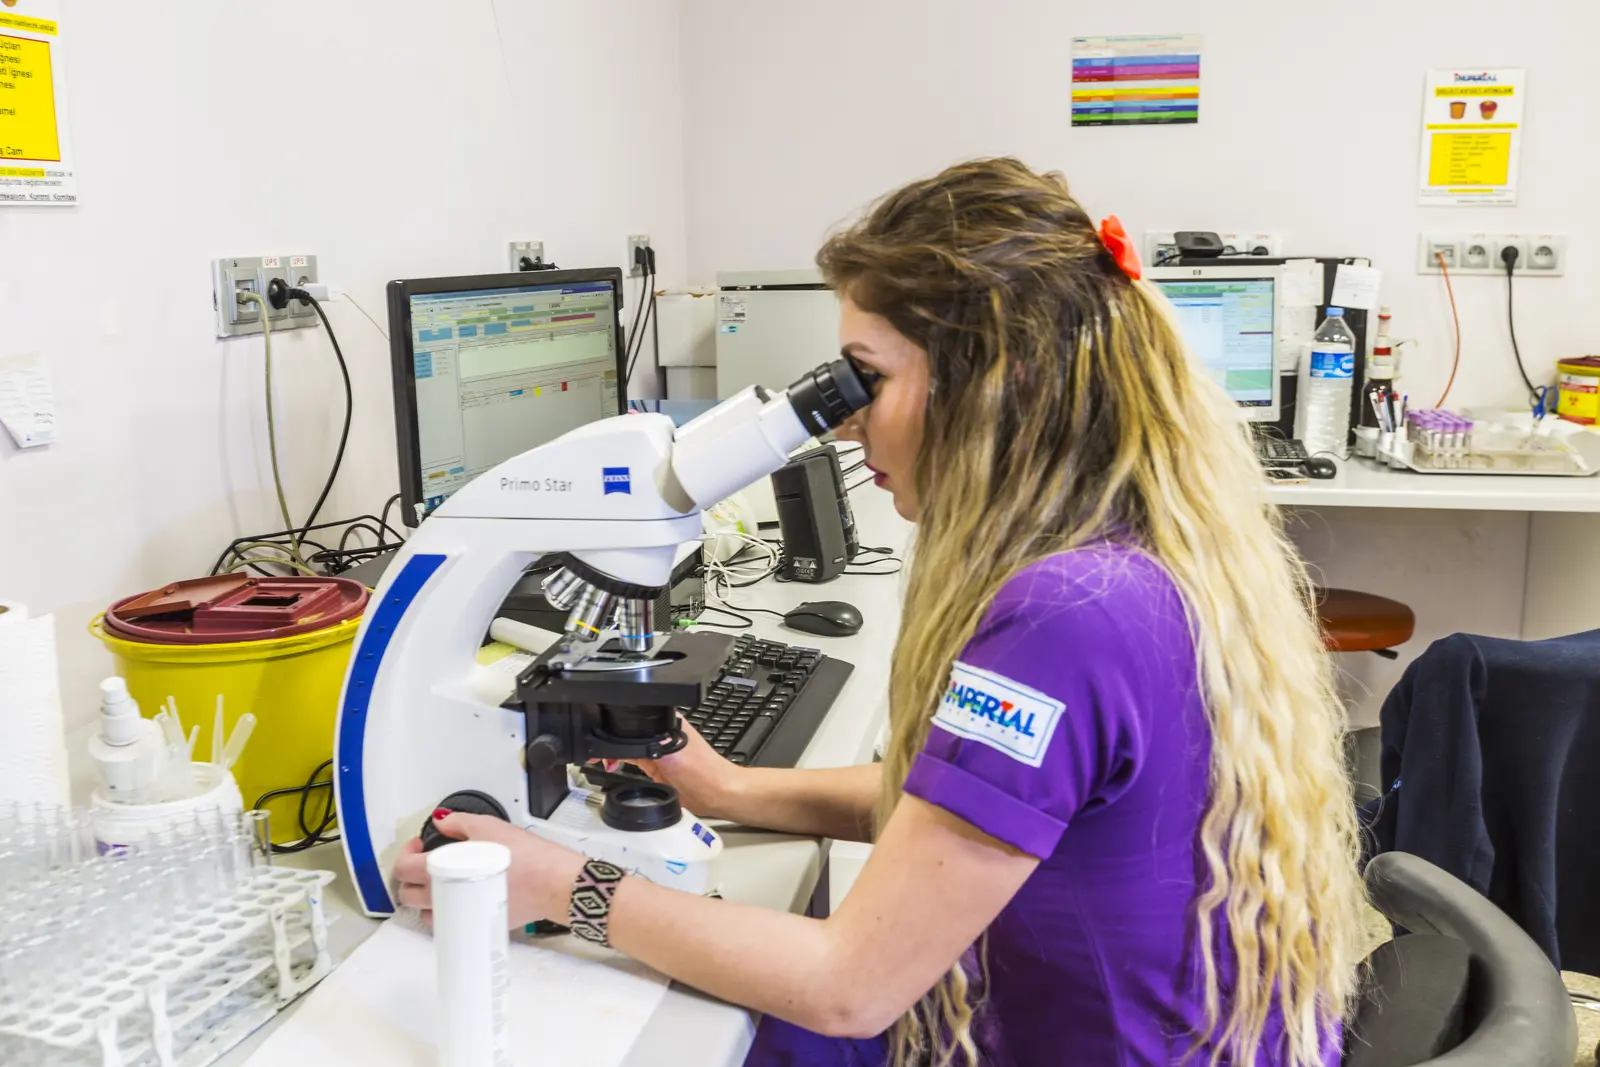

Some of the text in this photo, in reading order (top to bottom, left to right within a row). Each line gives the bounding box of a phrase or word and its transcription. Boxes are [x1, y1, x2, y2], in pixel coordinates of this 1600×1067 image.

[500, 477, 573, 492] Primo Star
[945, 680, 1036, 738] MPERIAL
